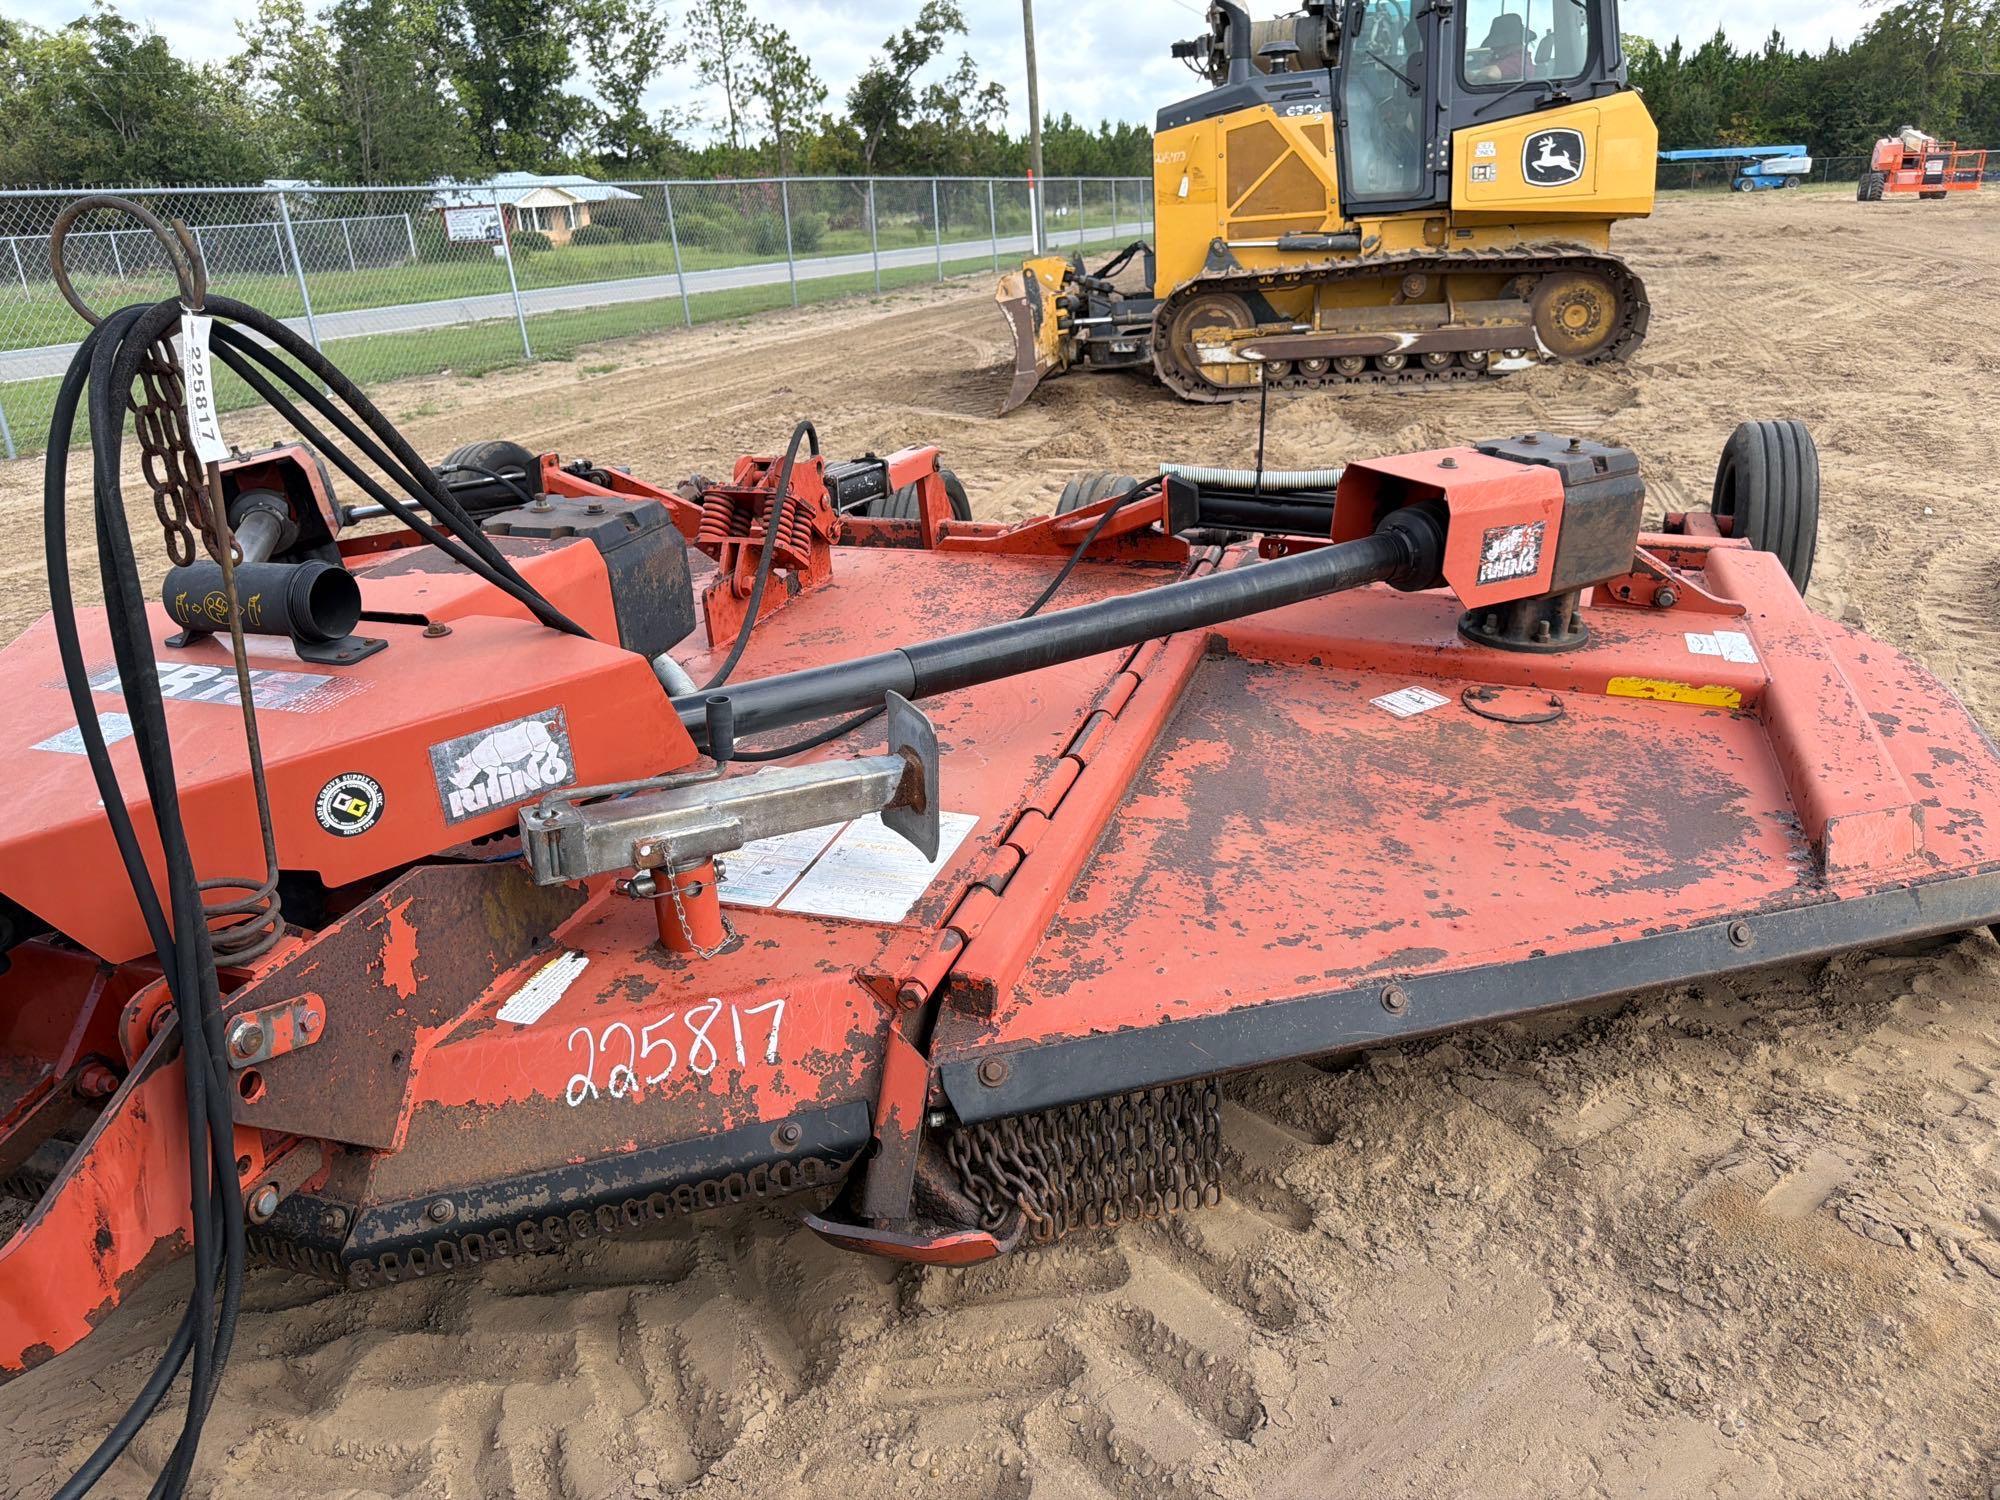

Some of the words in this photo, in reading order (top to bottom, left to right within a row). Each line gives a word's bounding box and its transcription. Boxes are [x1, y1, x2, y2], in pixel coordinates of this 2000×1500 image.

[191, 346, 216, 441] 225817
[319, 777, 341, 800] GROVE
[342, 774, 371, 783] SUPPLY
[448, 757, 568, 818] RHINO
[316, 806, 330, 828] GLADE
[343, 827, 363, 835] SINCE
[565, 997, 785, 1107] 225817
